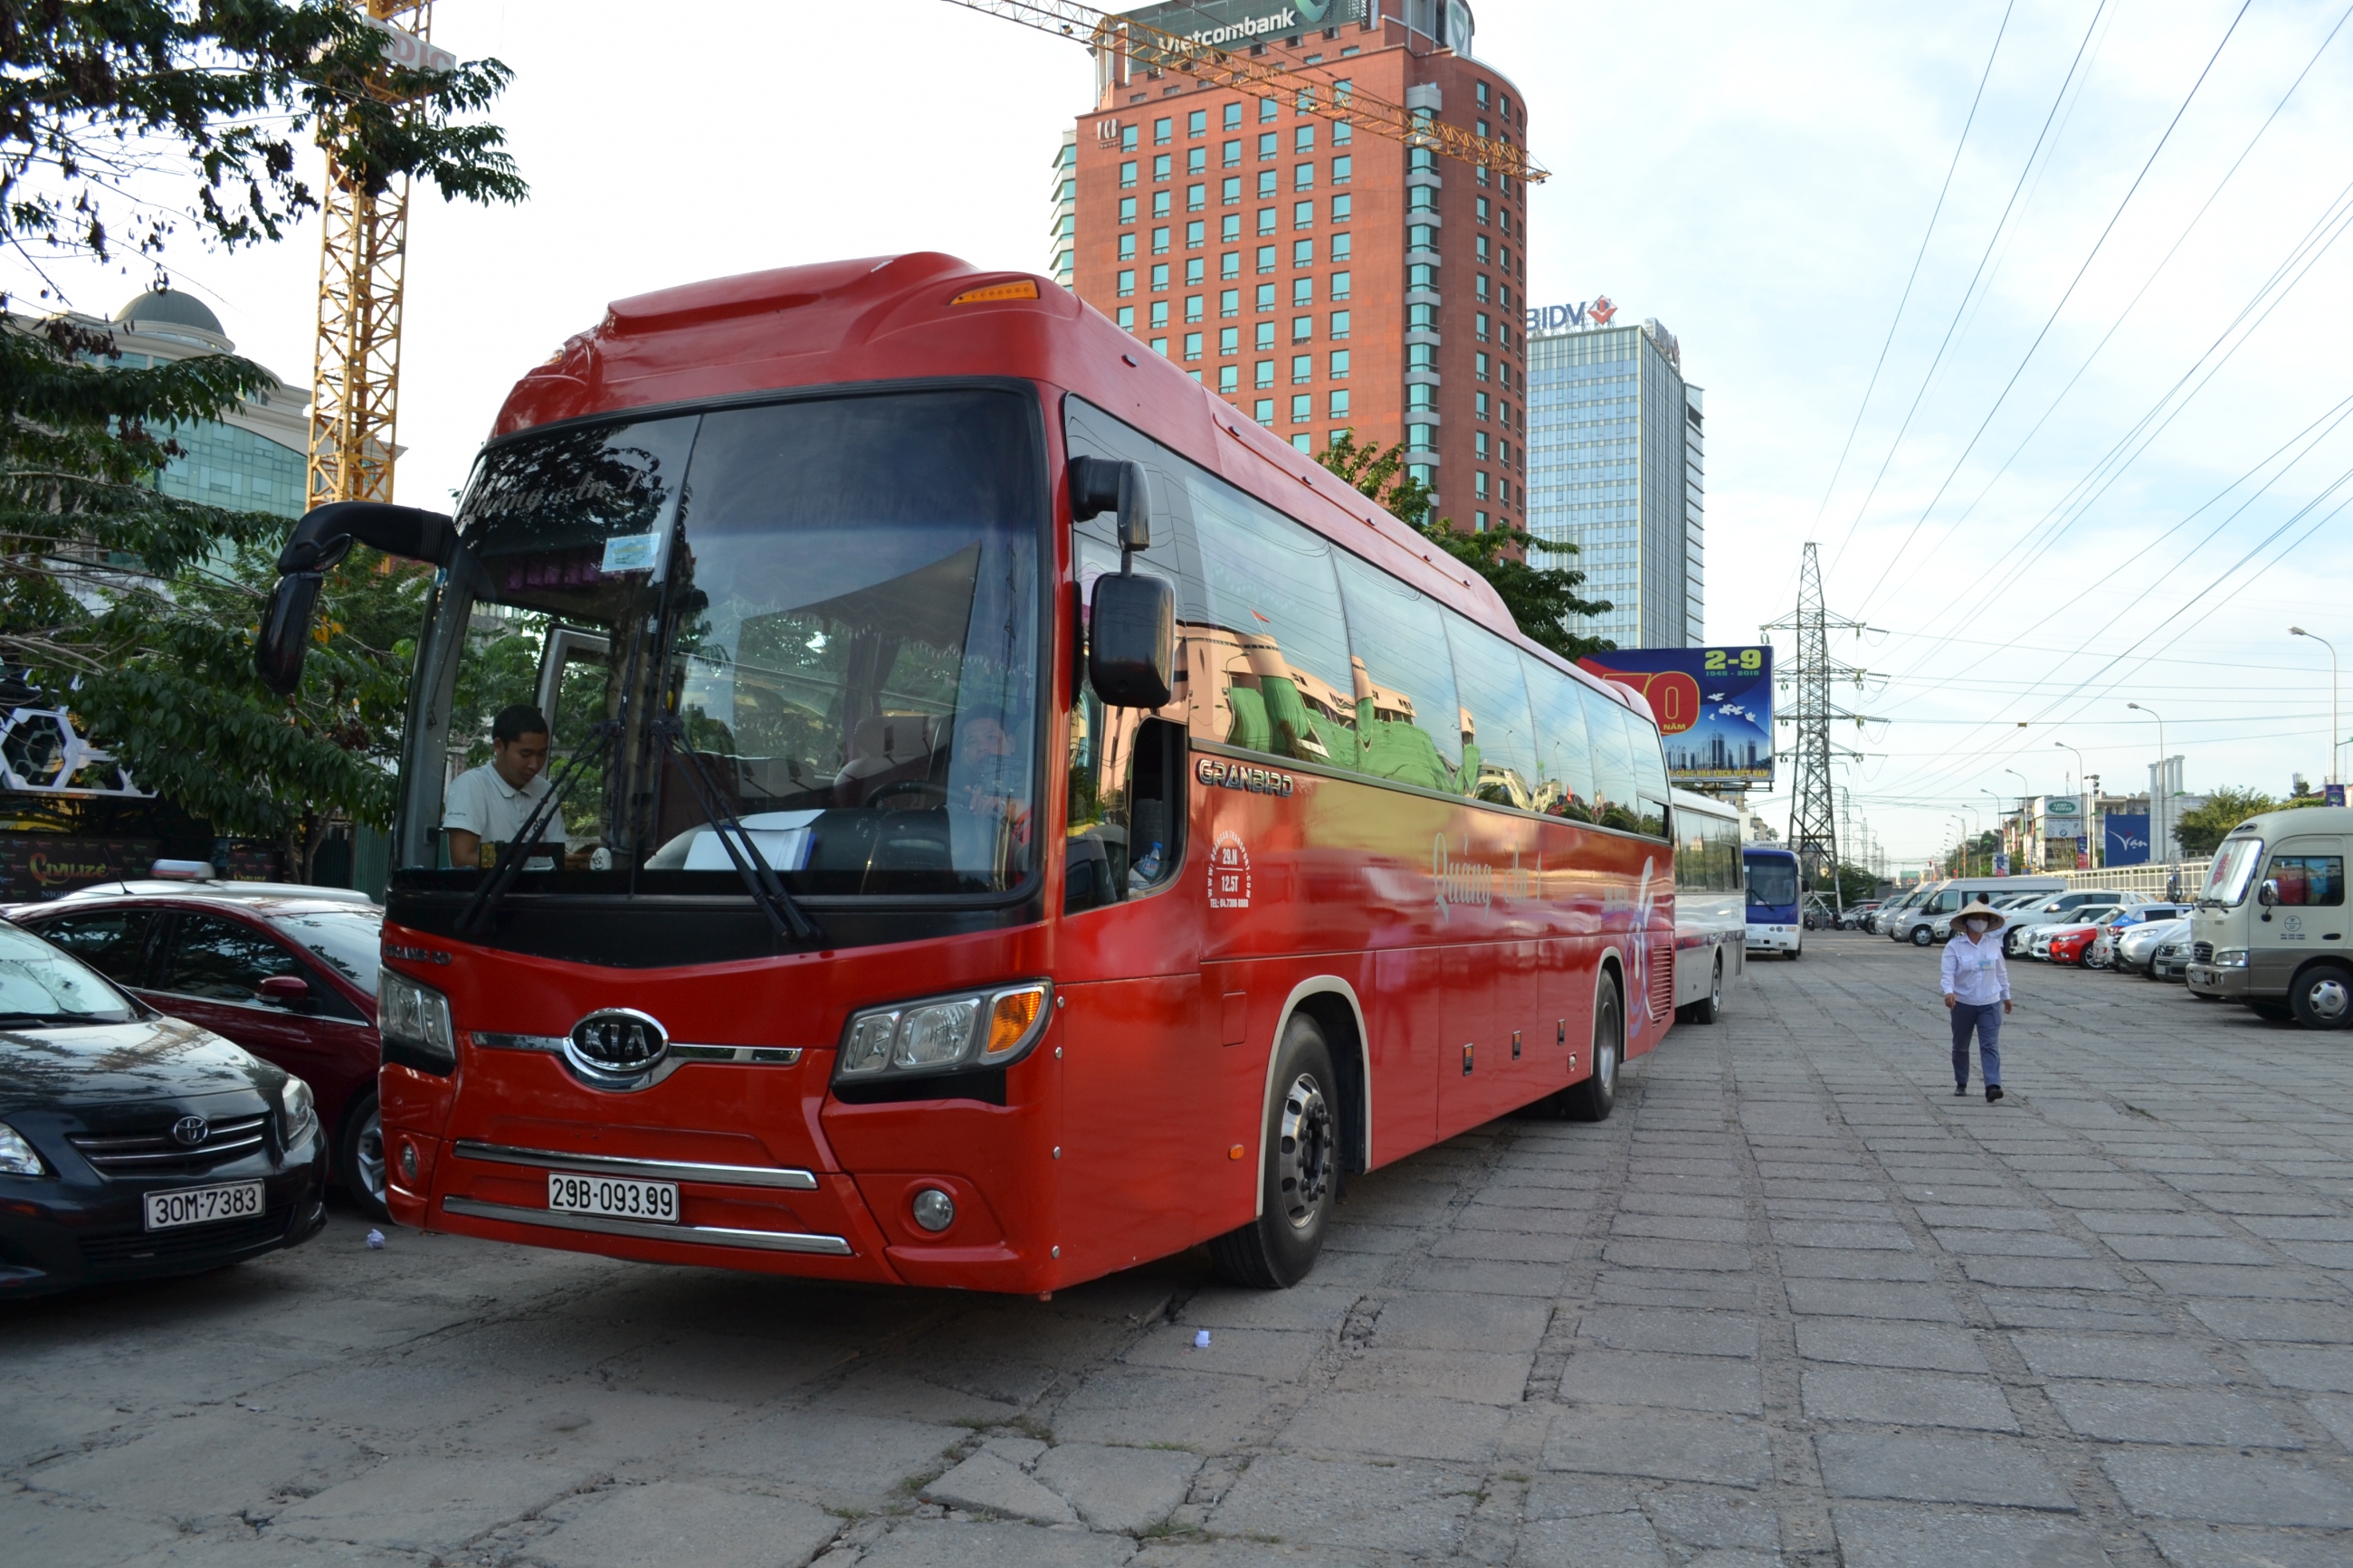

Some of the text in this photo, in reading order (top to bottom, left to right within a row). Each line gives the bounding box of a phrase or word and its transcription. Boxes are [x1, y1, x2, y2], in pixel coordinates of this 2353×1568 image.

[1097, 119, 1117, 140] VCB
[1526, 301, 1587, 331] BIDV
[1704, 649, 1762, 670] 2-9
[1663, 723, 1686, 731] NĂM
[1196, 758, 1294, 798] GRANBIRD
[1752, 769, 1769, 777] NAM
[1222, 848, 1238, 865] 29.N
[1221, 875, 1239, 893] 12.5T
[1210, 898, 1219, 908] TEL:
[585, 1023, 651, 1057] KIA
[551, 1177, 673, 1217] 29B-093.99
